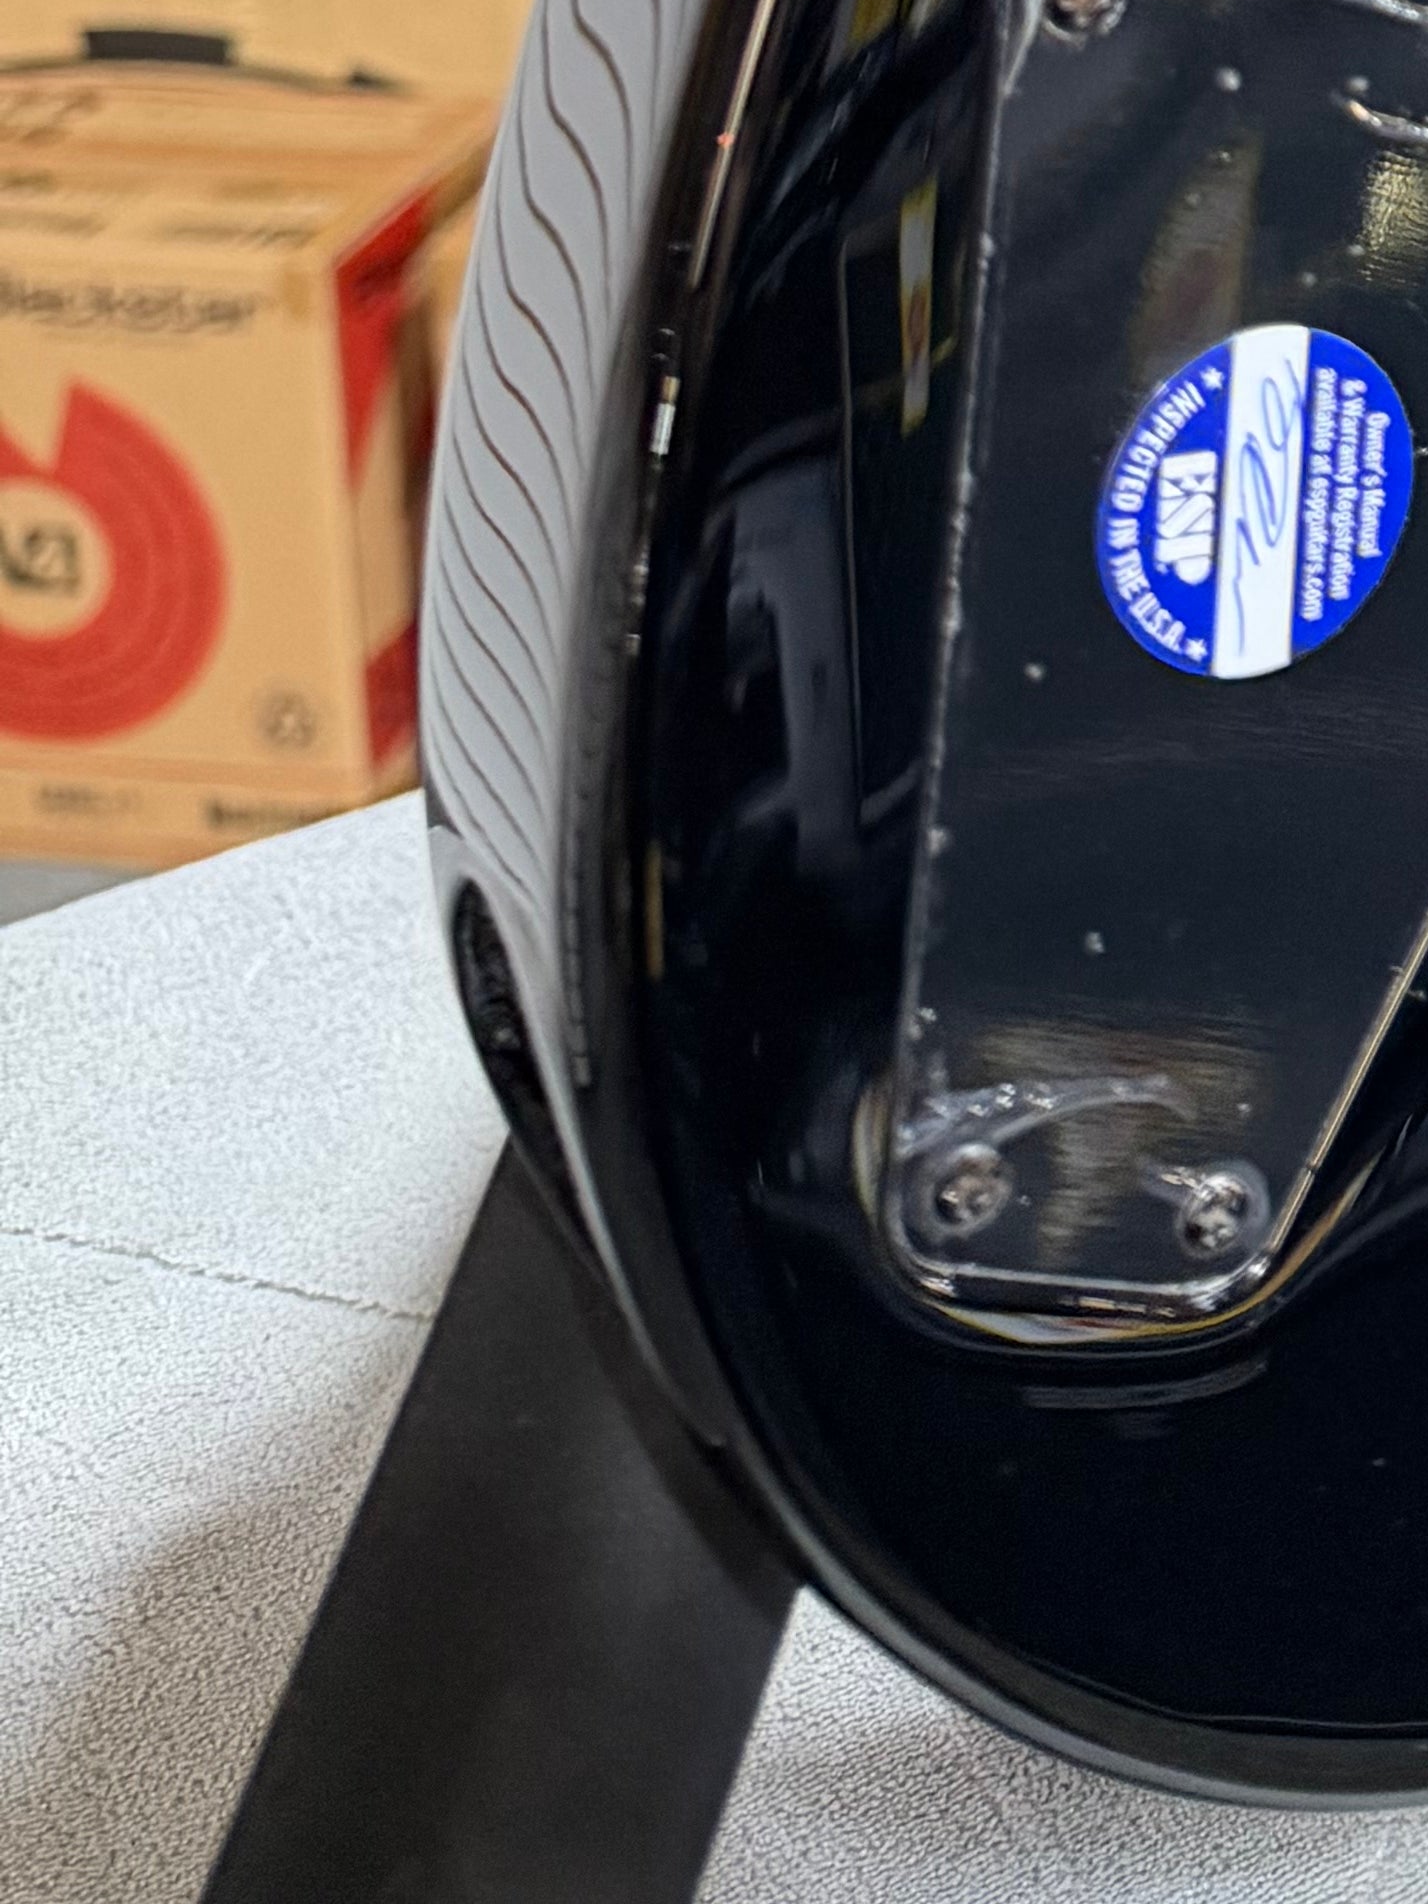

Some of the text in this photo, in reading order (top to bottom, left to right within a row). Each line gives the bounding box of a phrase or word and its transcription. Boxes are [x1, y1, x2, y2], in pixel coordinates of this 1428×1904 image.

[1111, 379, 1207, 513] INSPECTED
[1299, 366, 1338, 622] available at espguitars.com
[1327, 378, 1367, 601] & Warranty Registration
[1357, 411, 1391, 559] Owner's Manual
[1107, 517, 1140, 550] IN
[1109, 548, 1151, 603] THE
[1156, 450, 1218, 586] ESP
